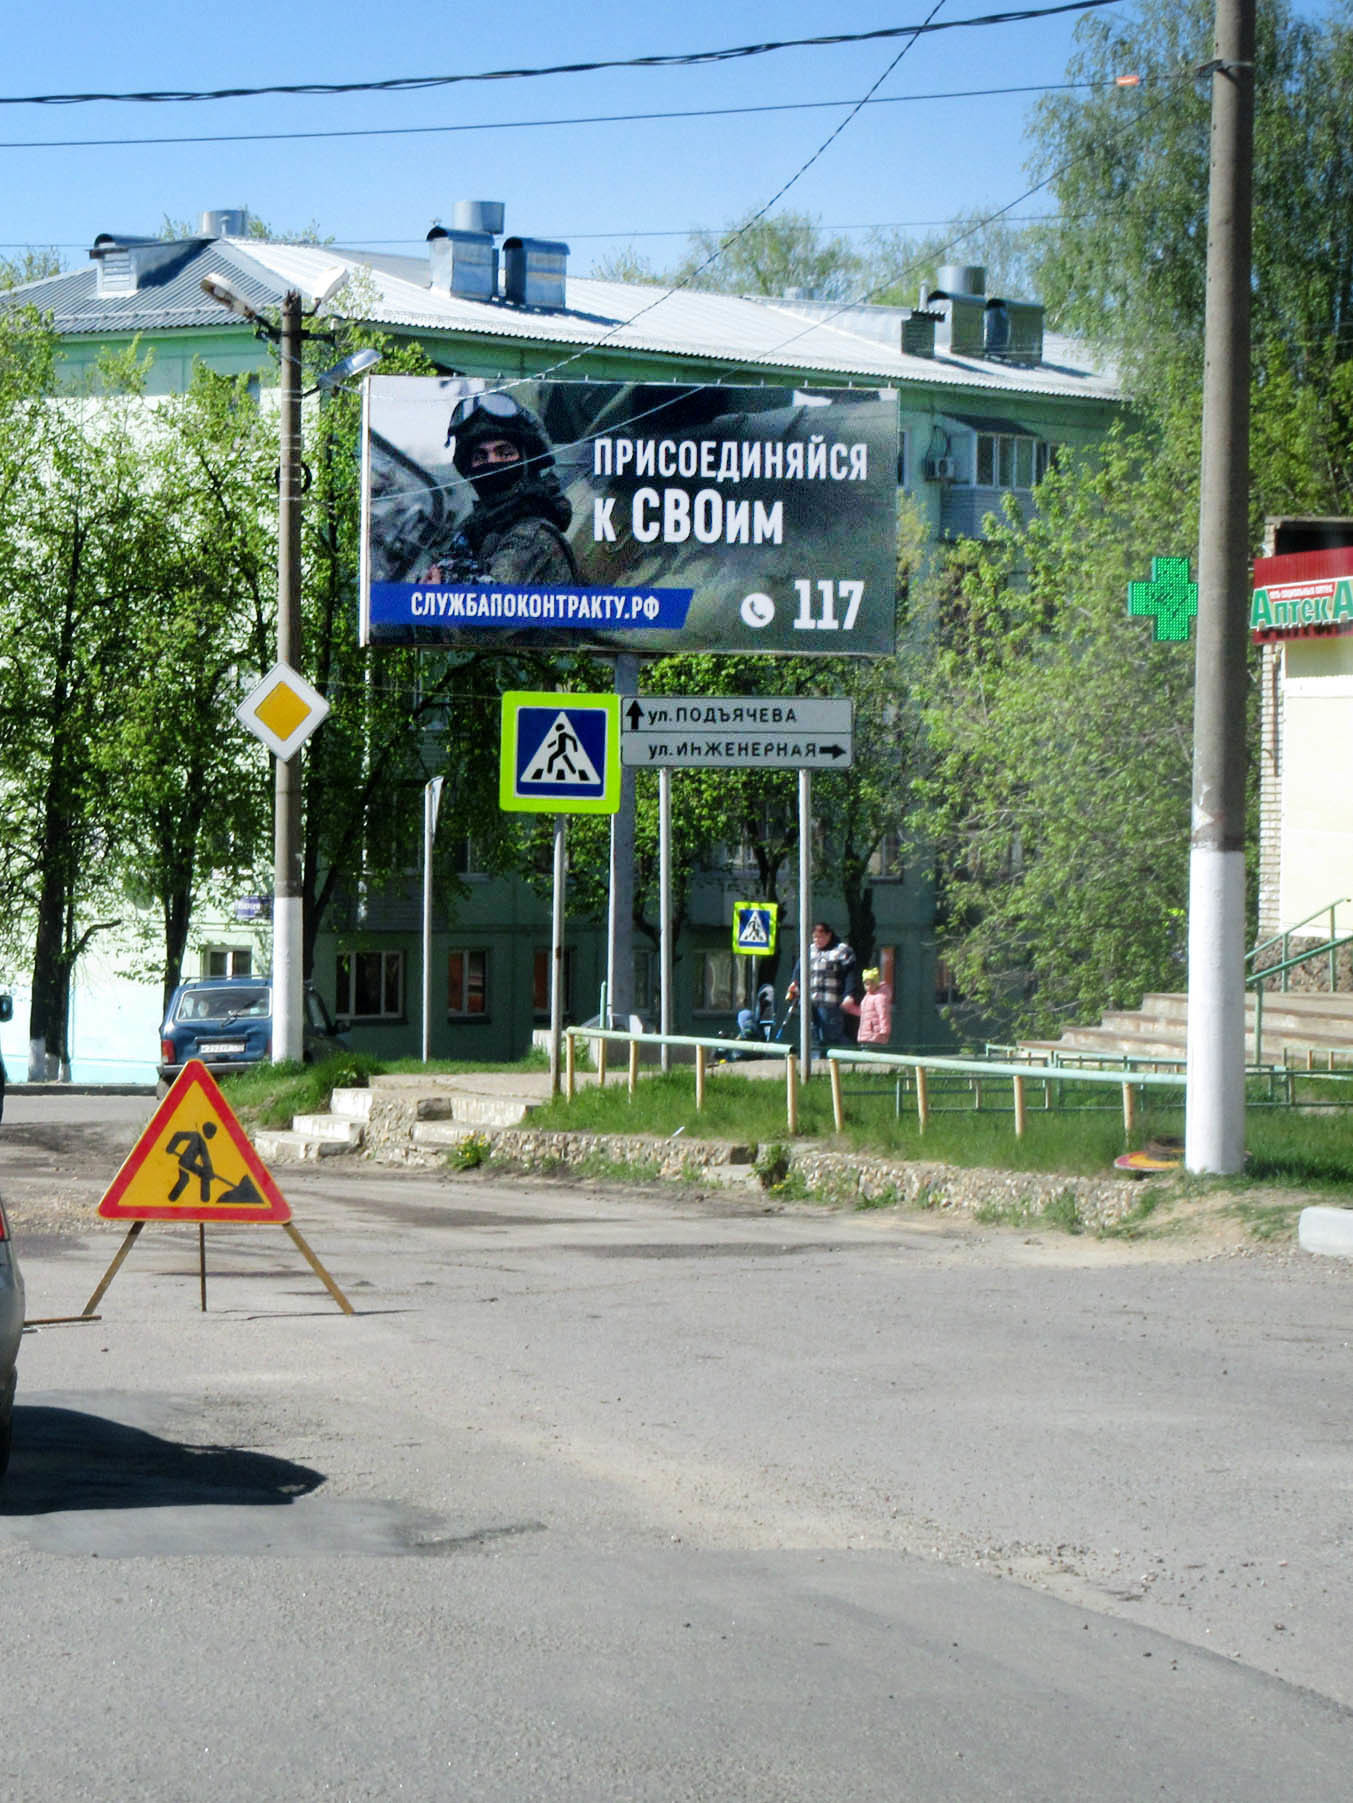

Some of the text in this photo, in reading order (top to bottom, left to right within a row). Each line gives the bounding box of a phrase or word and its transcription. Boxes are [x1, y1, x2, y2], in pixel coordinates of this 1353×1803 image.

[593, 434, 868, 483] ПРИСОЕДИНЯЙСЯ
[410, 591, 660, 620] СЛУЖБАПОКОНТРАКТУ.РФ
[793, 579, 865, 631] 117
